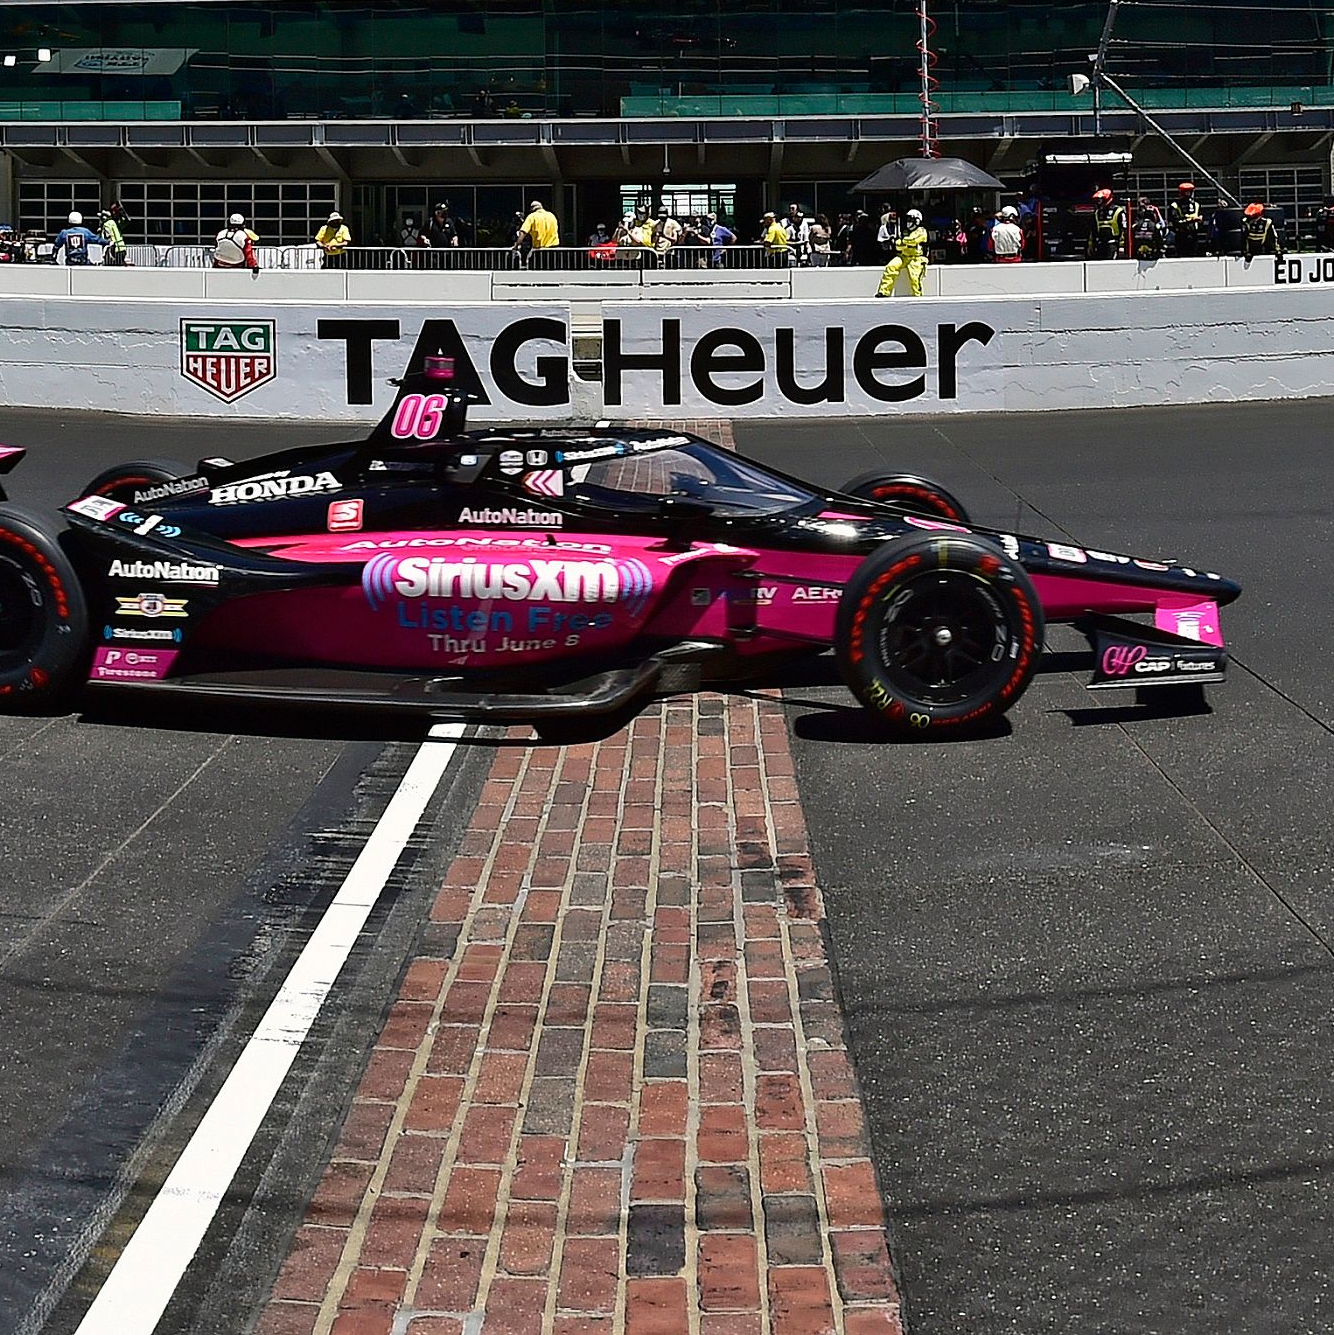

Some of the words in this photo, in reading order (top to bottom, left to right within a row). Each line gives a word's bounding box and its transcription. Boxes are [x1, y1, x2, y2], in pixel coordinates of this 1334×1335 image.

[1274, 259, 1303, 285] ED
[189, 325, 265, 351] TAG
[187, 355, 269, 396] HEUER
[392, 393, 448, 440] 06
[133, 475, 209, 505] AutoNation
[208, 470, 343, 506] HONDA
[458, 506, 563, 526] AutoNation
[340, 535, 612, 555] AutoNation
[108, 559, 220, 581] AutoNation
[397, 601, 513, 632] Listen
[528, 606, 613, 631] Free
[427, 633, 486, 653] Thru
[495, 636, 556, 652] June
[564, 634, 580, 646] 8
